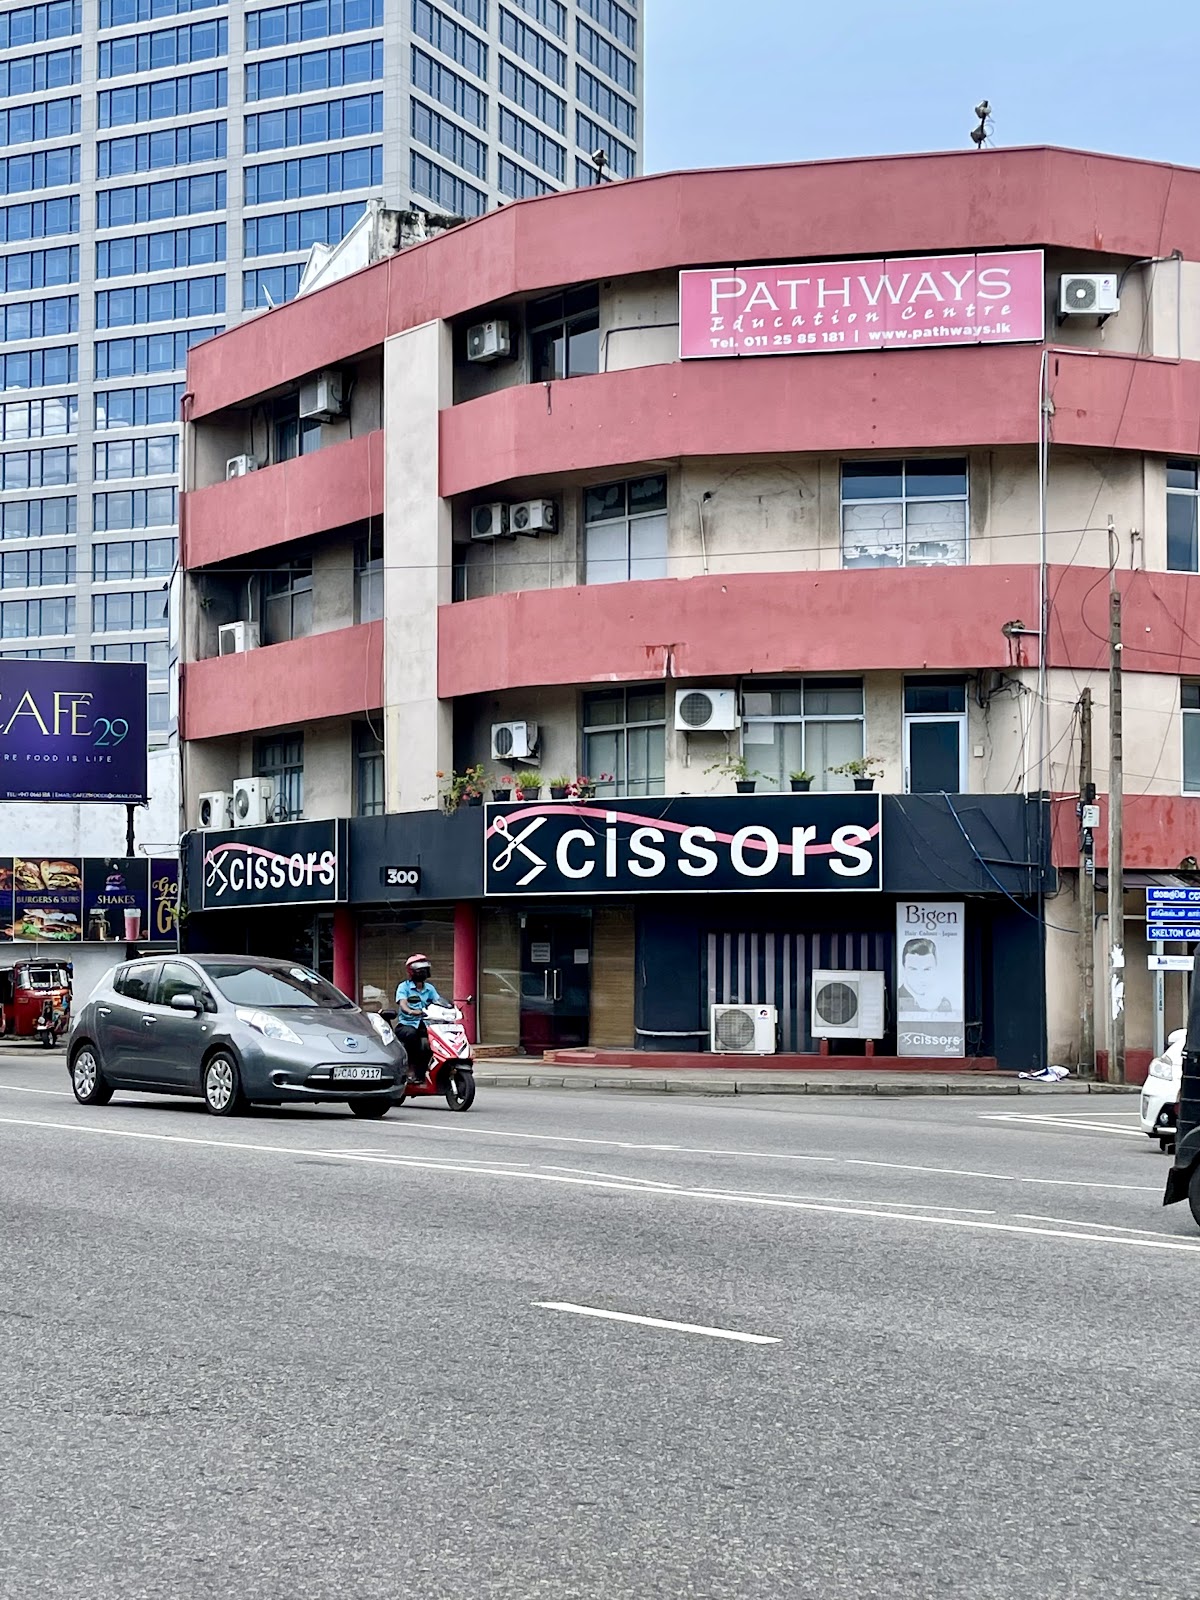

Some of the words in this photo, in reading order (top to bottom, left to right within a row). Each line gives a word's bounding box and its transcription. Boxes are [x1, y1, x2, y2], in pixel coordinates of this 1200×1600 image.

[710, 268, 1012, 314] PATHWAYS
[710, 309, 880, 333] Education
[901, 303, 1012, 320] Centre
[710, 337, 738, 349] Tel.
[744, 335, 768, 347] 011
[773, 334, 792, 345] 25
[797, 333, 816, 344] 85
[821, 331, 845, 343] 181
[868, 323, 1011, 341] www.pathways.lk
[0, 690, 94, 736] AFÉ
[93, 717, 129, 747] 29
[26, 754, 59, 762] FOOD
[86, 755, 112, 763] LIFE
[387, 868, 419, 884] 300
[16, 895, 53, 904] BURGERS
[53, 895, 60, 904] &
[60, 895, 80, 904] SUBS
[97, 894, 136, 904] SHAKES
[905, 904, 958, 931] Bigen
[1151, 928, 1184, 938] SKELTON
[360, 1068, 380, 1079] 9117
